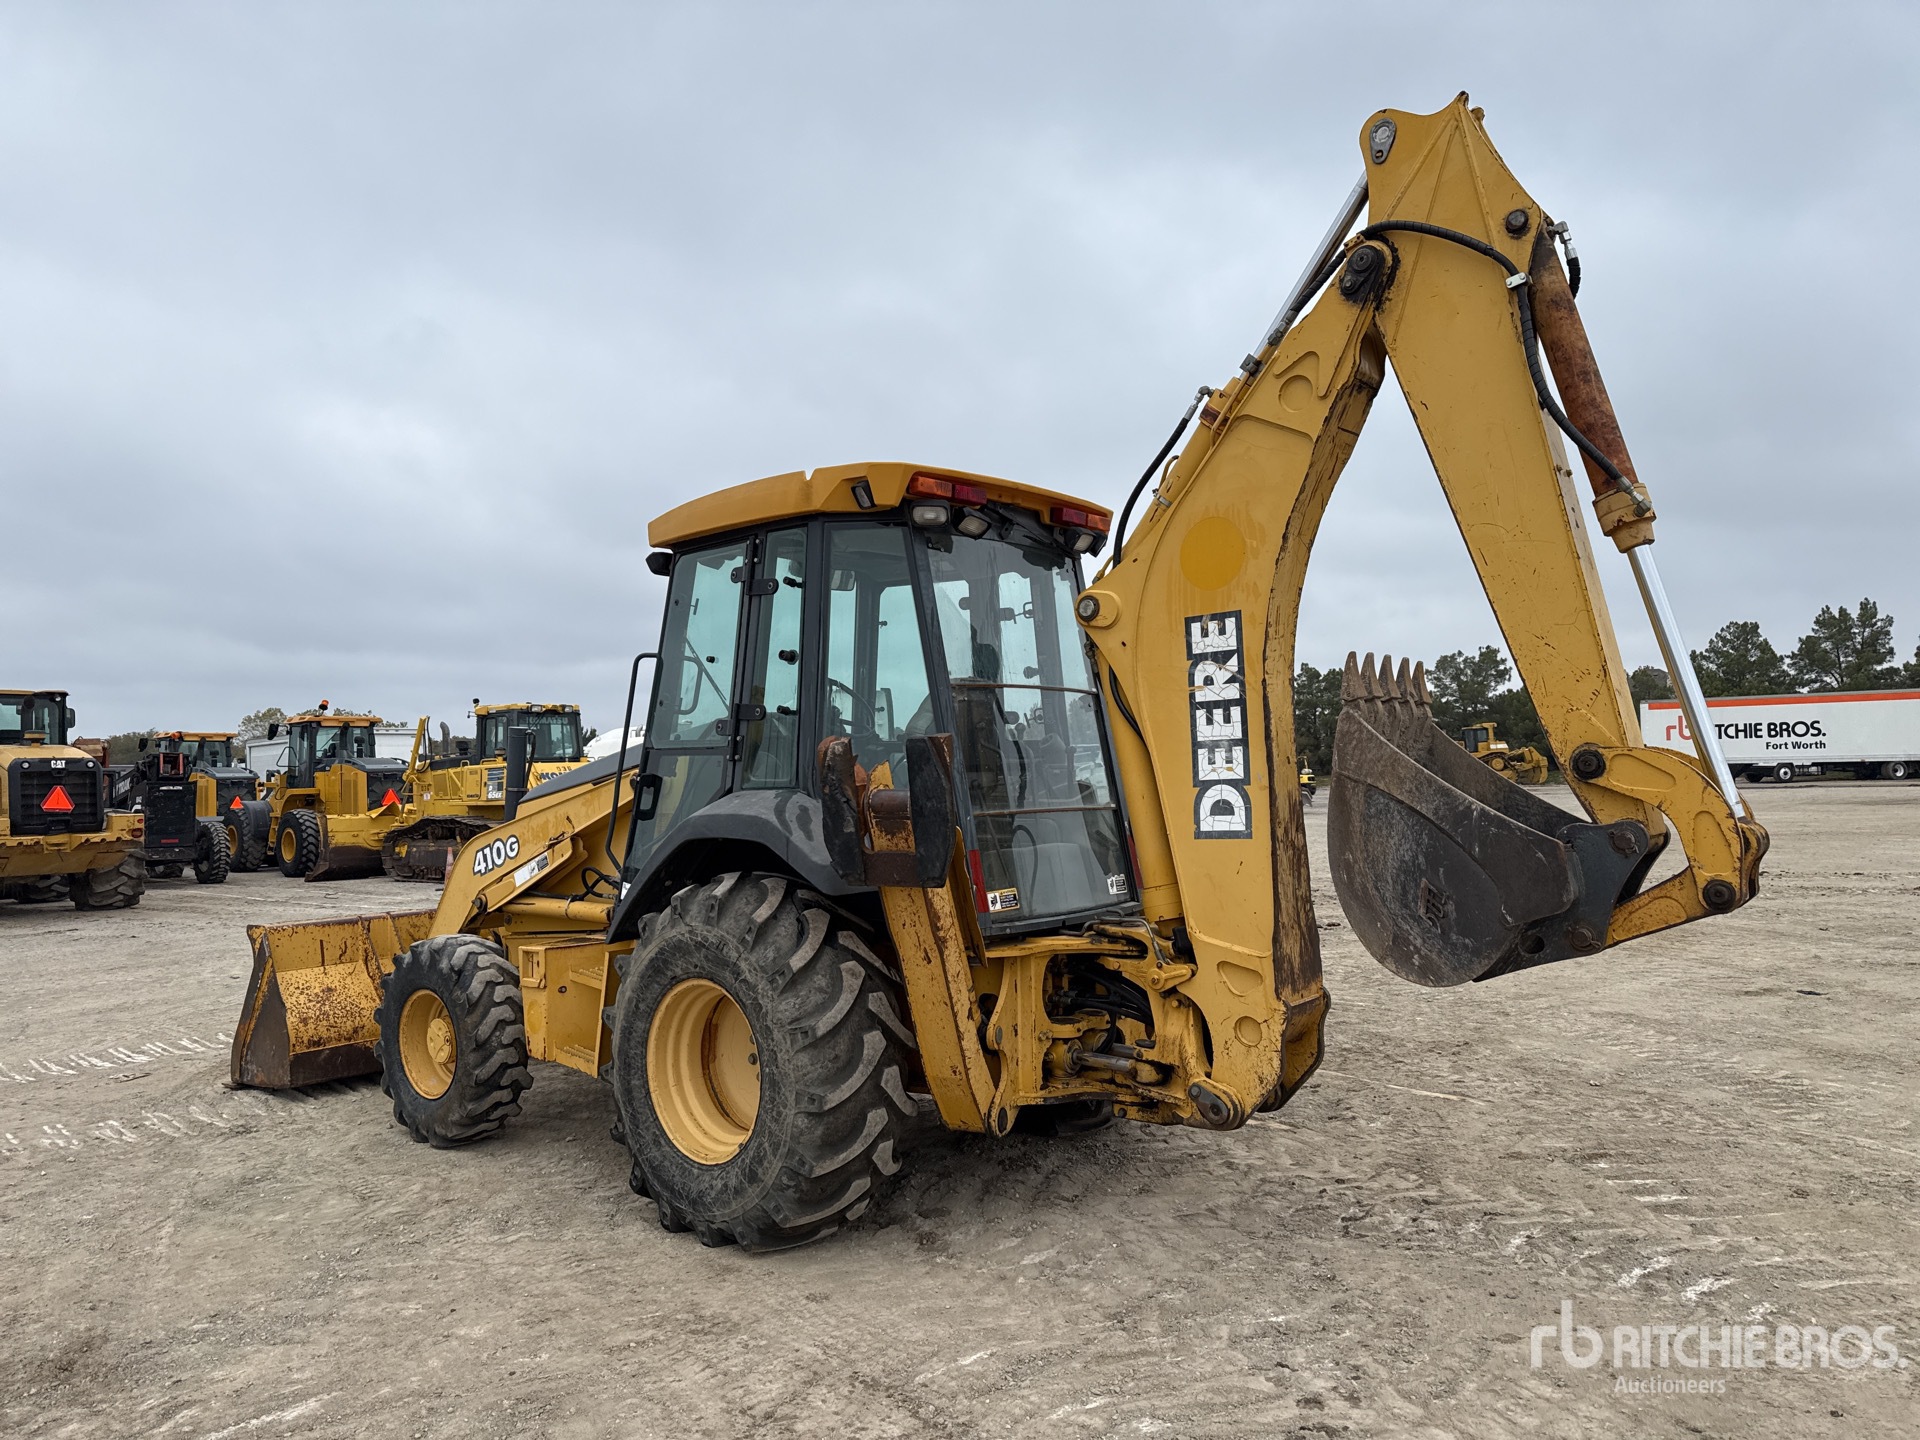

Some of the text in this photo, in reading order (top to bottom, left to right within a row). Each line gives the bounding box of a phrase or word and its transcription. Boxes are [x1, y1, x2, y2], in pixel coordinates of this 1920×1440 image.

[1190, 616, 1247, 832] DEERE
[1714, 720, 1827, 740] TCHIE BROS.
[1766, 740, 1826, 750] Fort Worth
[51, 760, 66, 769] CAT
[474, 835, 519, 876] 410G
